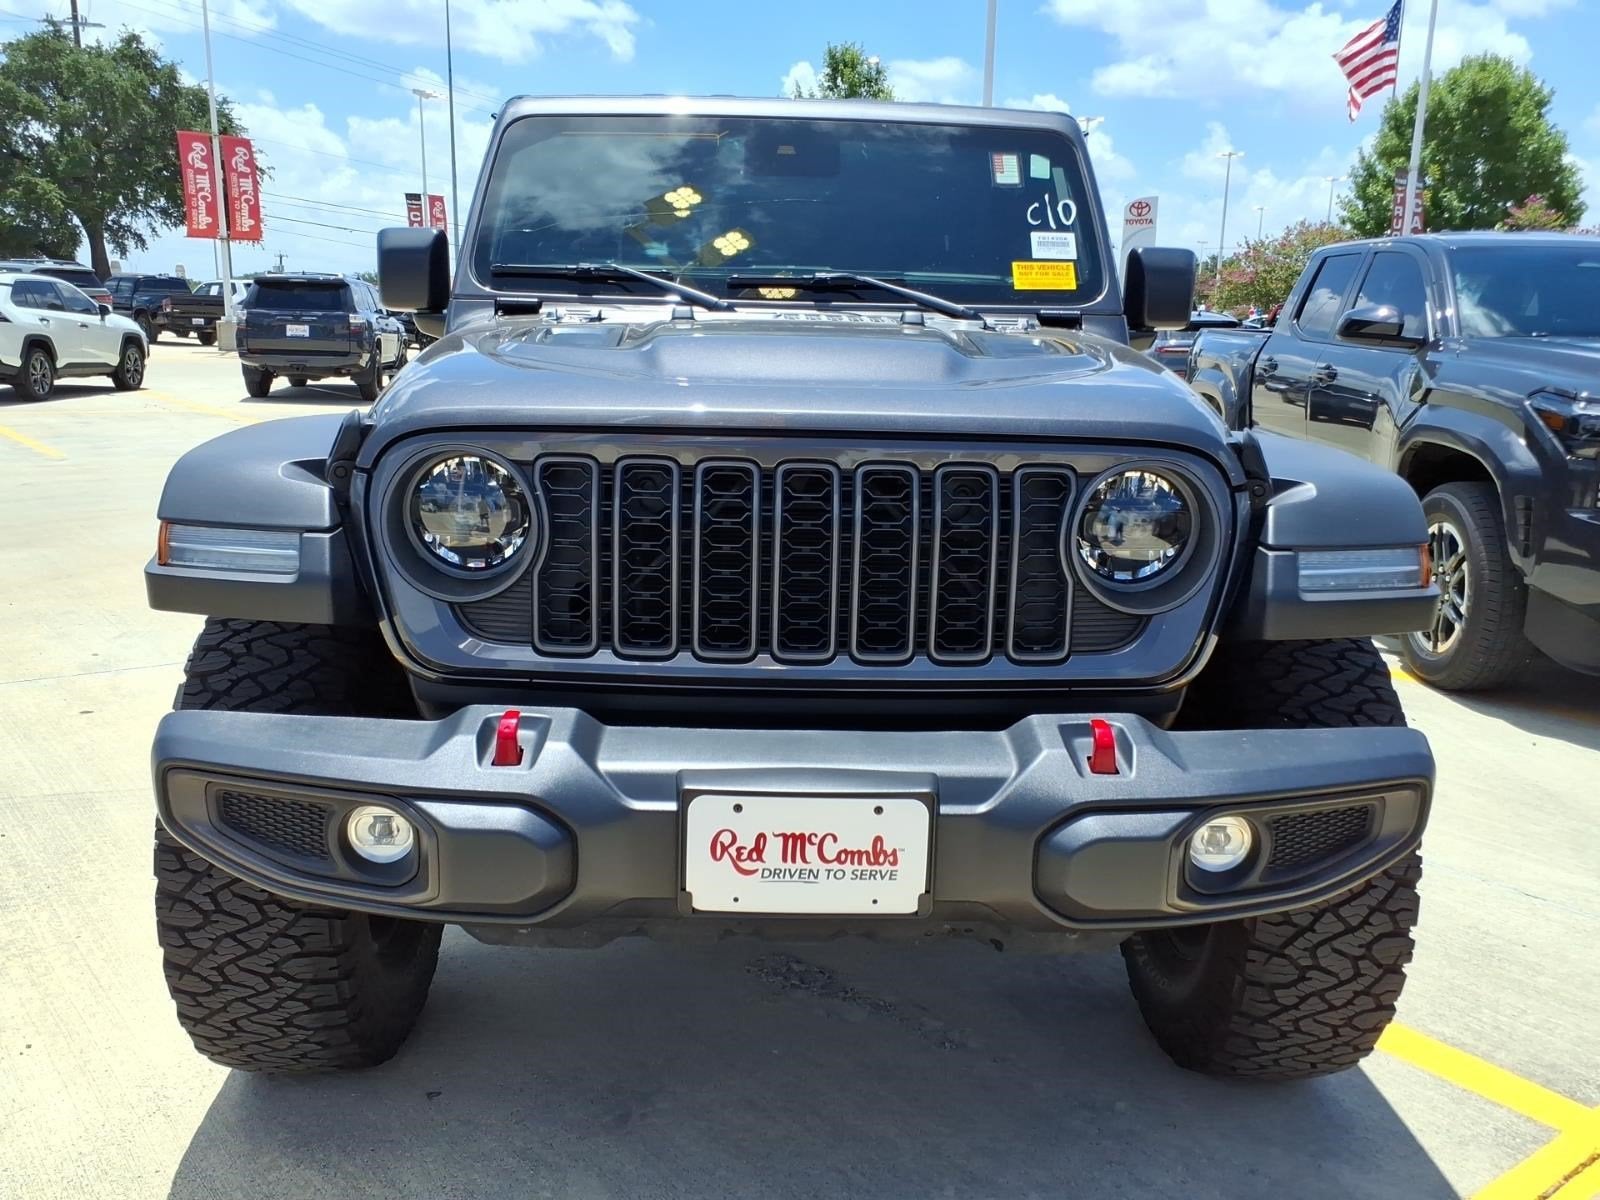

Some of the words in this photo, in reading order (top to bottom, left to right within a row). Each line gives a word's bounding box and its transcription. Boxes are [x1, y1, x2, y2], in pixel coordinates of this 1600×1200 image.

[188, 142, 208, 169] Red
[232, 147, 251, 173] Red
[196, 171, 212, 230] McCombs
[240, 175, 255, 232] McCombs
[710, 829, 768, 876] Red
[772, 832, 899, 867] McCombs
[760, 868, 820, 881] DRIVEN
[824, 868, 846, 881] TO
[849, 869, 899, 882] SERVE
